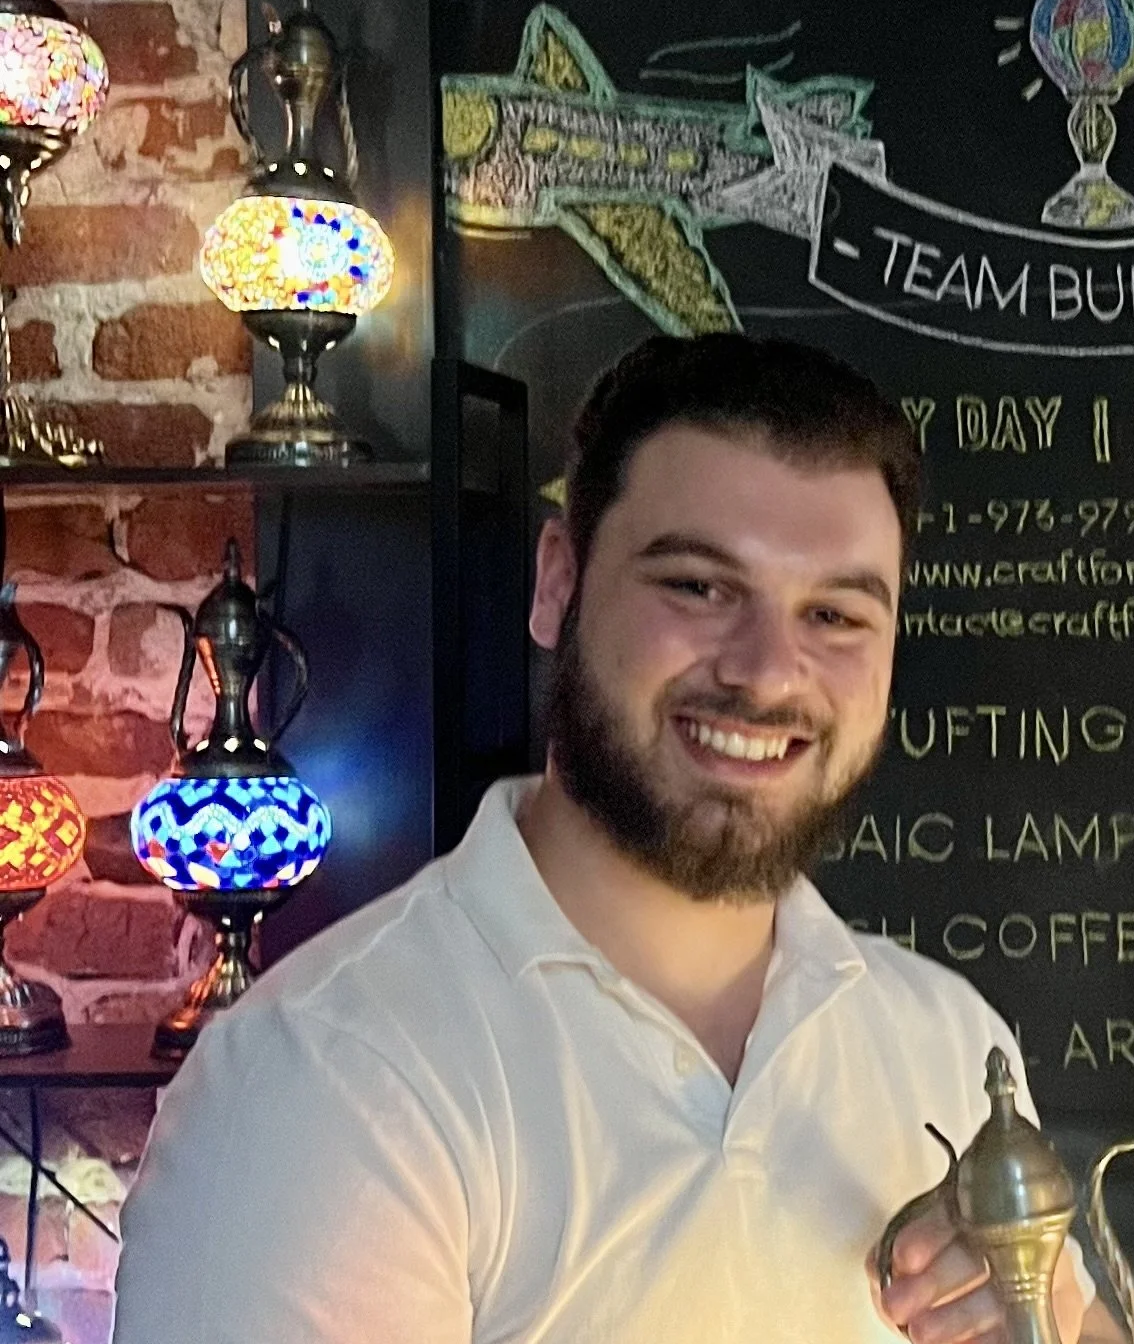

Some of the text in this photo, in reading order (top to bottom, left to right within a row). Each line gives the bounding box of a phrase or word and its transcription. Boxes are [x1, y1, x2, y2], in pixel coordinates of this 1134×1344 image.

[873, 226, 1029, 316] TEAM
[956, 394, 1062, 453] DAY
[891, 705, 1128, 766] UFTING
[823, 811, 955, 864] AIC
